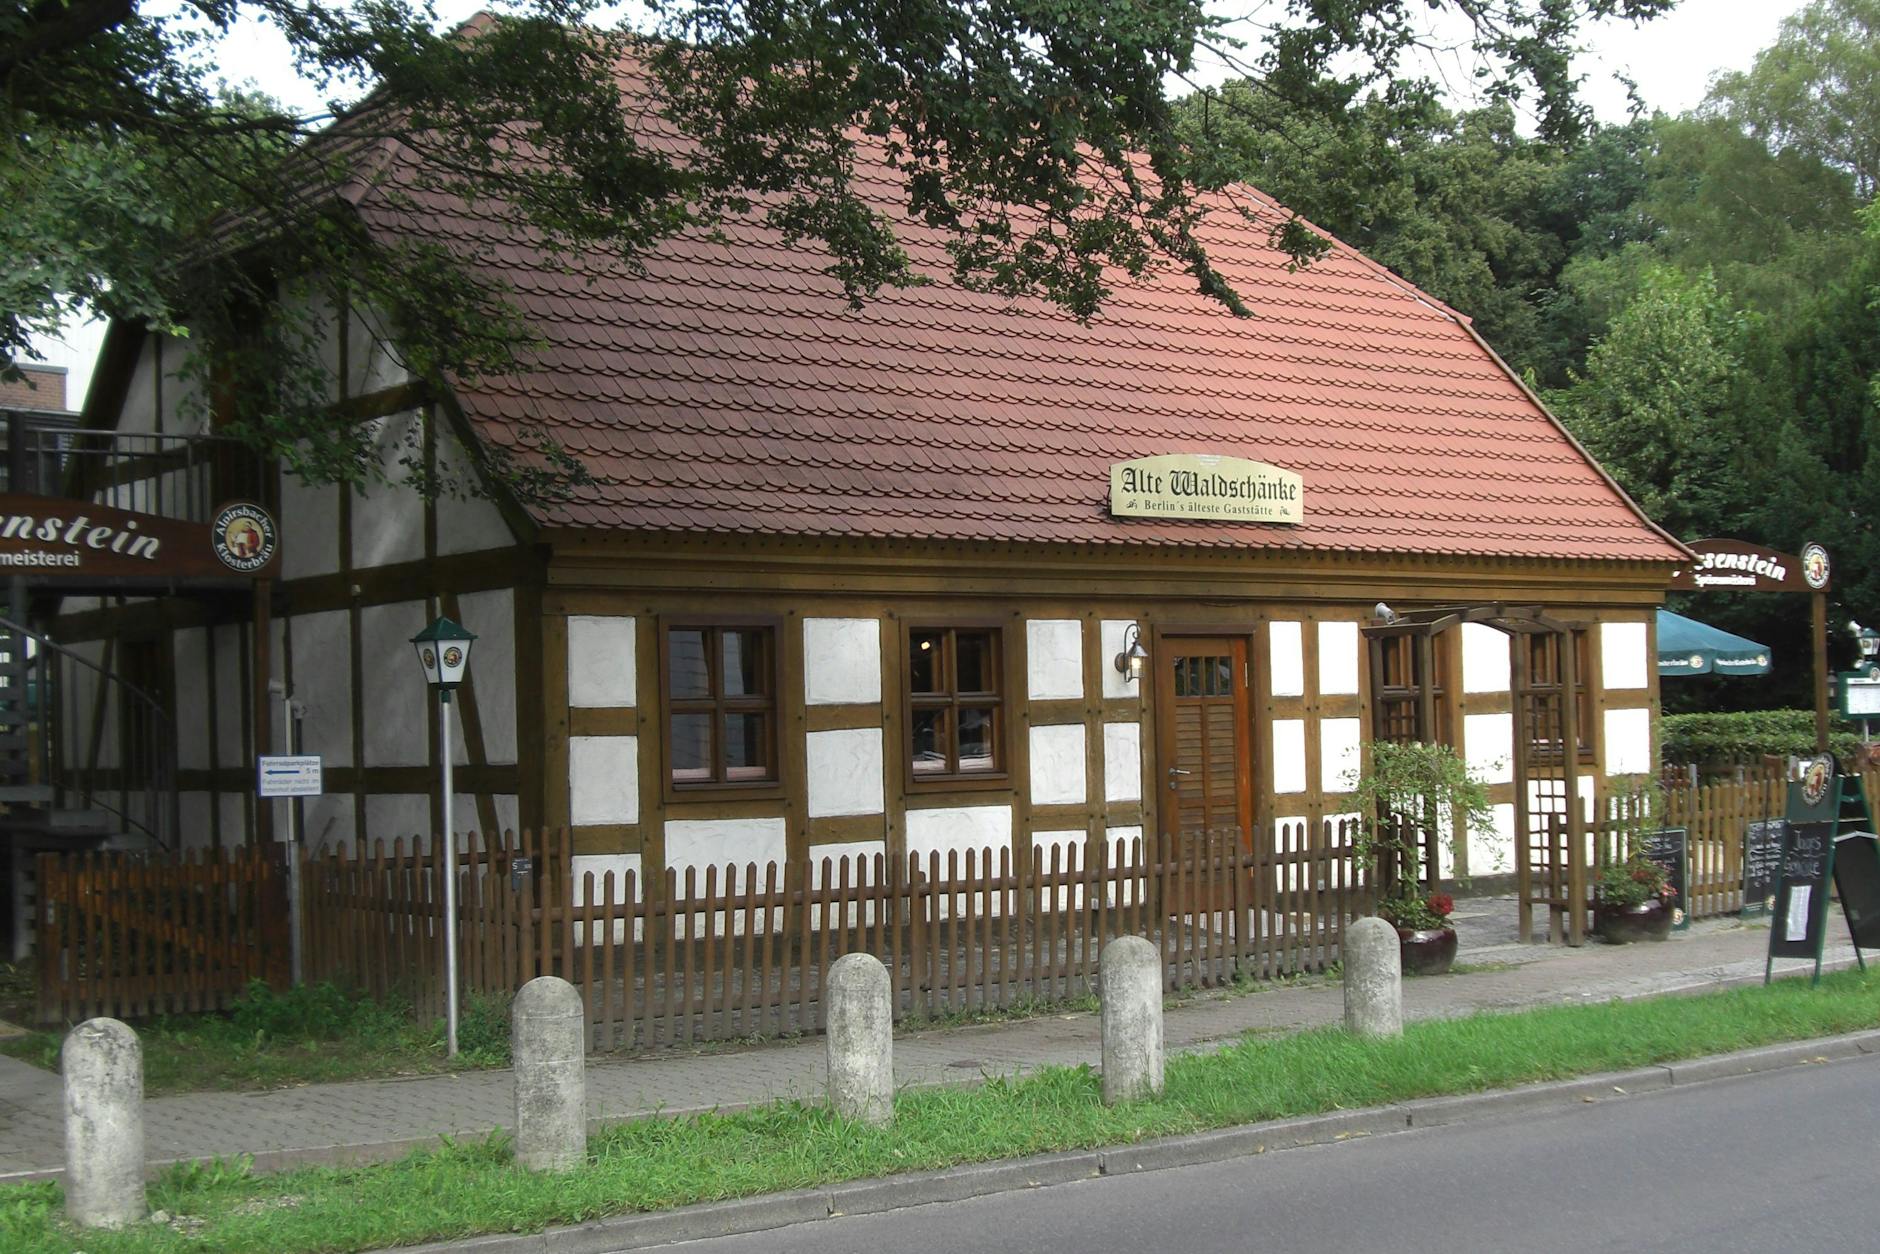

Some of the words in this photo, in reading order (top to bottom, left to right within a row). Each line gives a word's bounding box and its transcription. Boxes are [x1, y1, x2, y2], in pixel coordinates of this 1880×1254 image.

[1121, 467, 1162, 495] Alte
[1169, 470, 1297, 502] Waldschänke
[1188, 501, 1220, 514] älteste
[1223, 504, 1273, 516] Gaststätte
[0, 515, 160, 559] nstein
